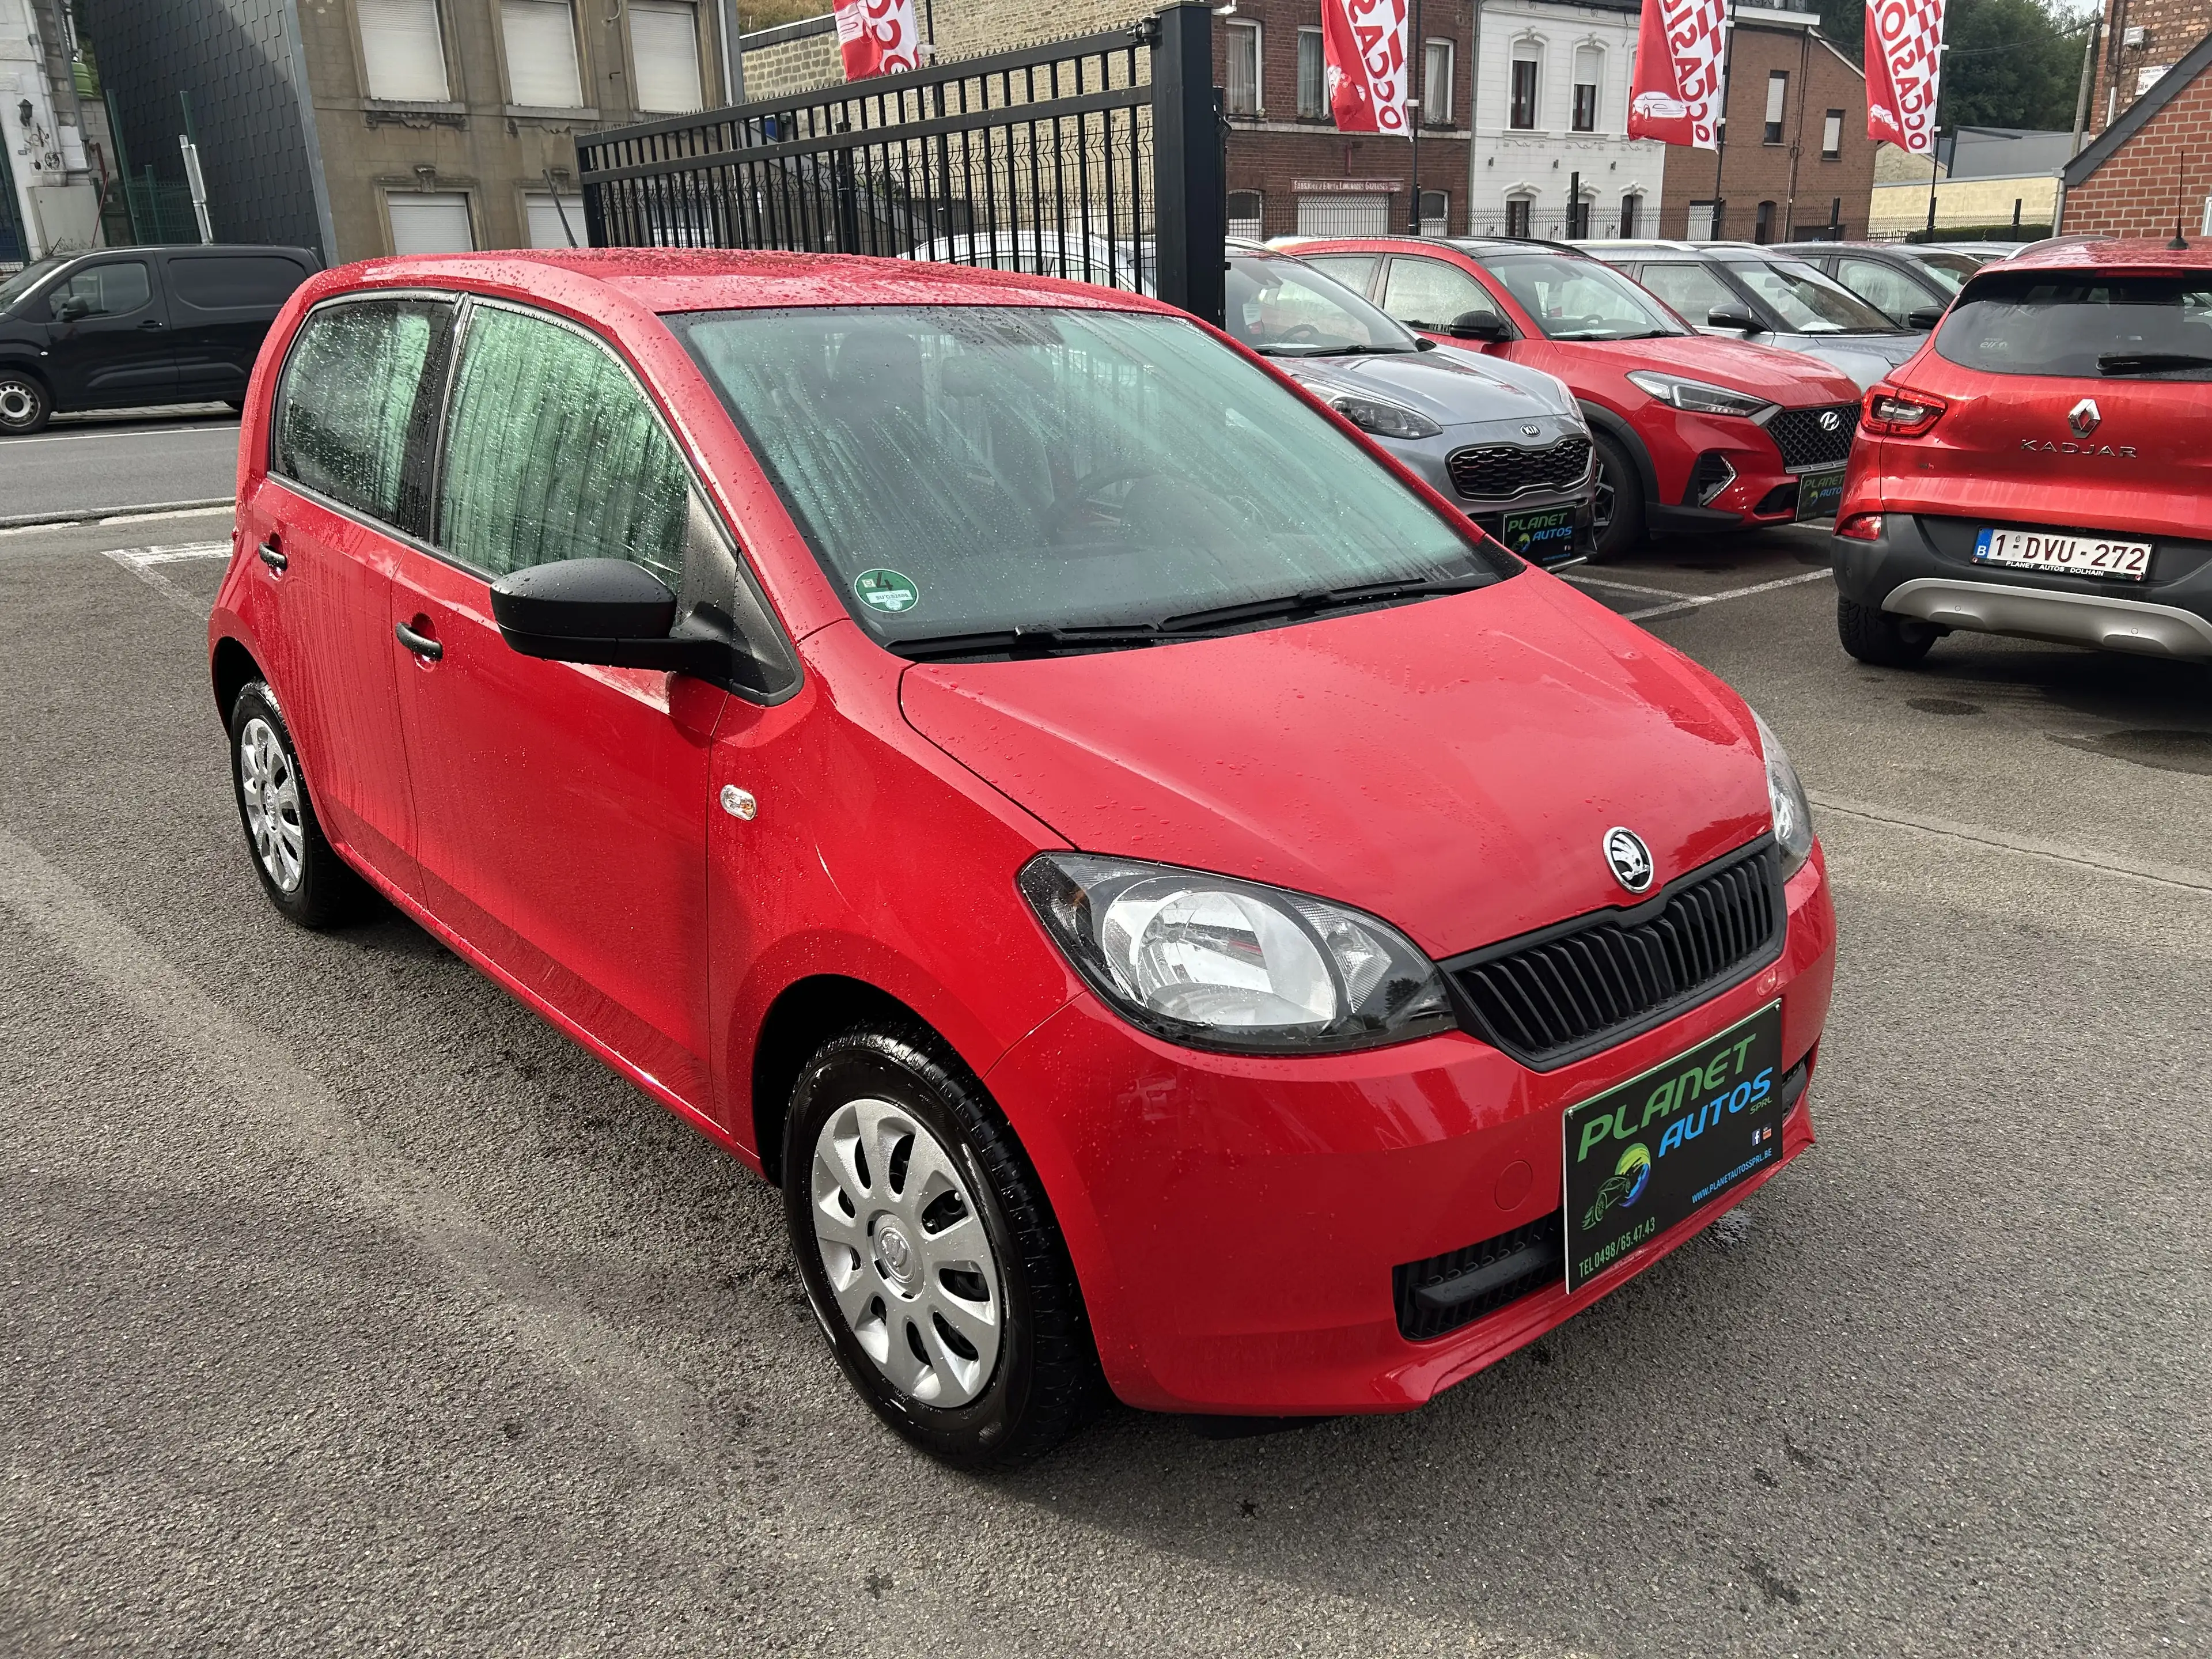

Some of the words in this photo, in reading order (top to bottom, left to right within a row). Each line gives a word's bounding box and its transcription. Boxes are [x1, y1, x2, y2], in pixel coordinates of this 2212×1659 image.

[1523, 426, 1539, 434] KIA
[2021, 439, 2137, 459] KADJAR
[1804, 475, 1845, 490] PLANET
[1819, 486, 1842, 498] AUTO
[1507, 512, 1567, 532] PLANET
[1532, 525, 1573, 541] AUTOS
[1976, 545, 1986, 556] B
[2039, 563, 2065, 573] AUTOS
[2070, 567, 2104, 577] DOLHAIN
[876, 572, 893, 590] 4
[1577, 1033, 1756, 1162] PLANET
[1750, 1096, 1772, 1115] SPRL
[1658, 1067, 1773, 1158] AUTOS
[1691, 1147, 1772, 1204] WWW.PLANETAUTOSSPRL.BE
